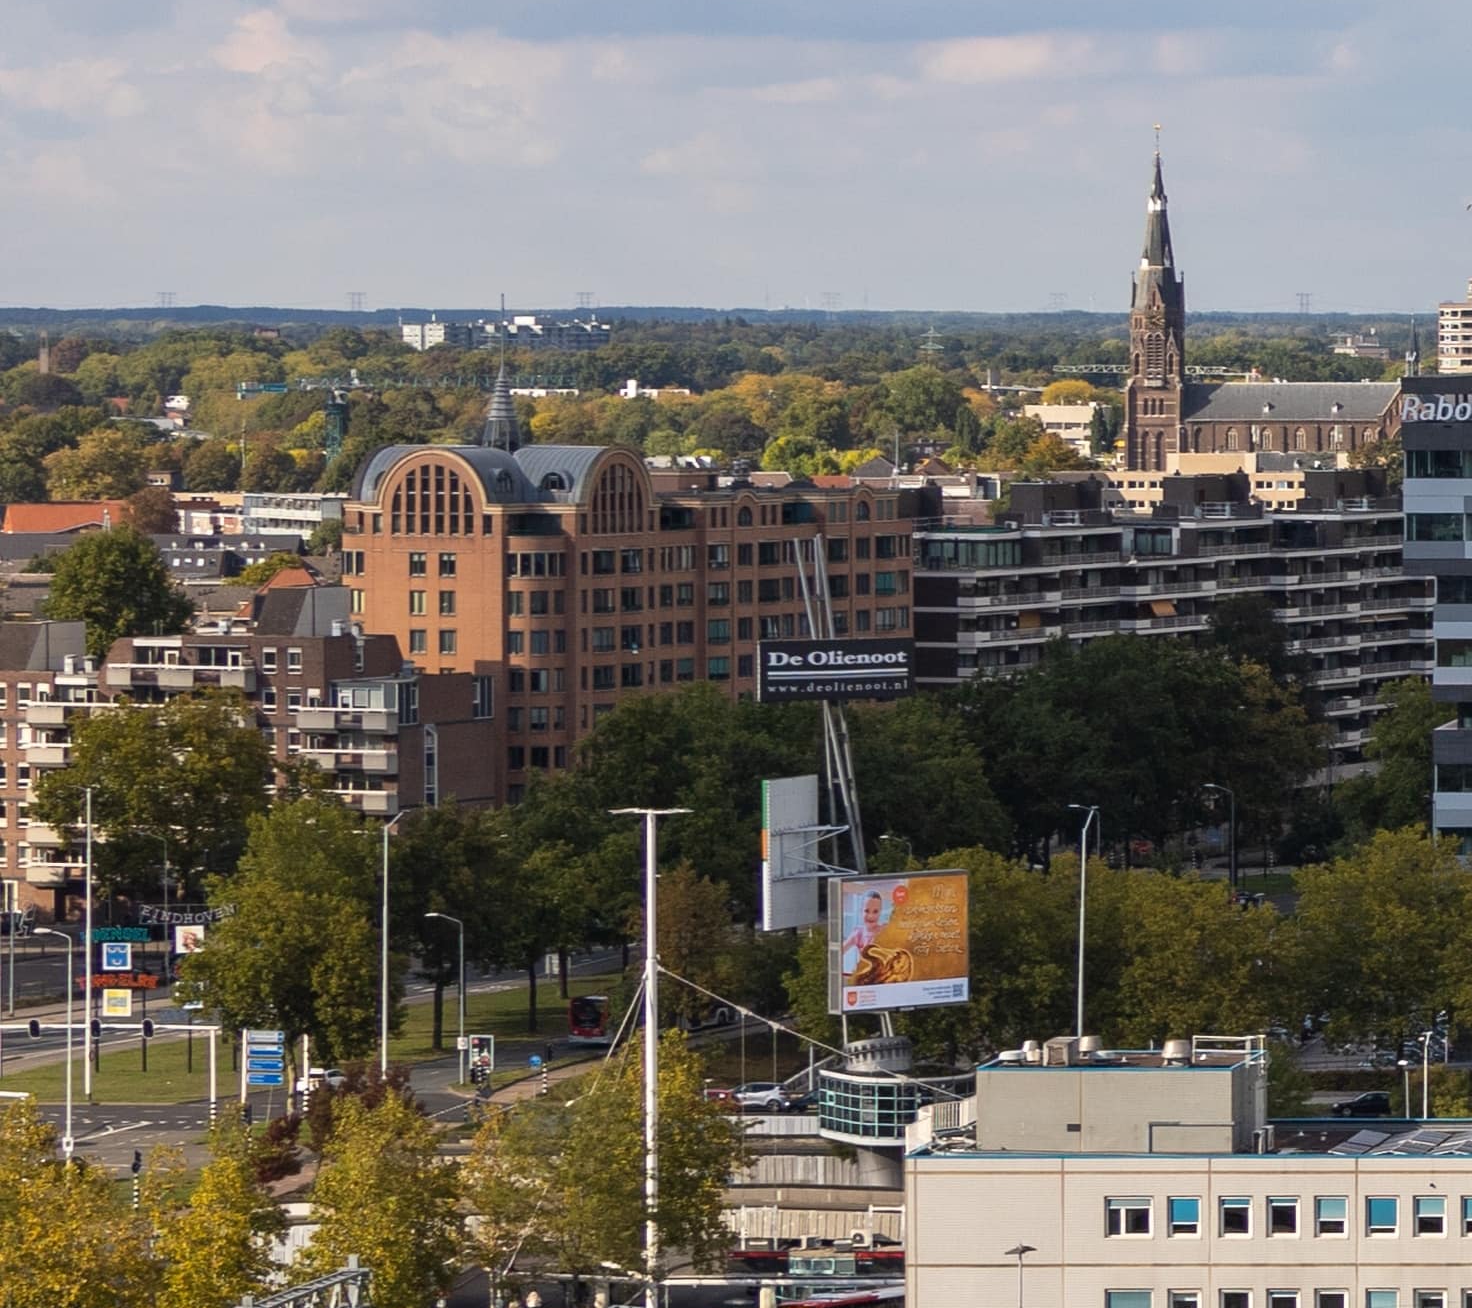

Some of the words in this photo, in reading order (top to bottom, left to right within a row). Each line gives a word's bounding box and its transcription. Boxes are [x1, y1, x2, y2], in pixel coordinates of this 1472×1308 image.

[767, 651, 803, 667] De
[807, 649, 908, 666] Olienoot
[767, 679, 908, 693] www.deolienoot.nl
[139, 903, 238, 924] EINDHOVEN
